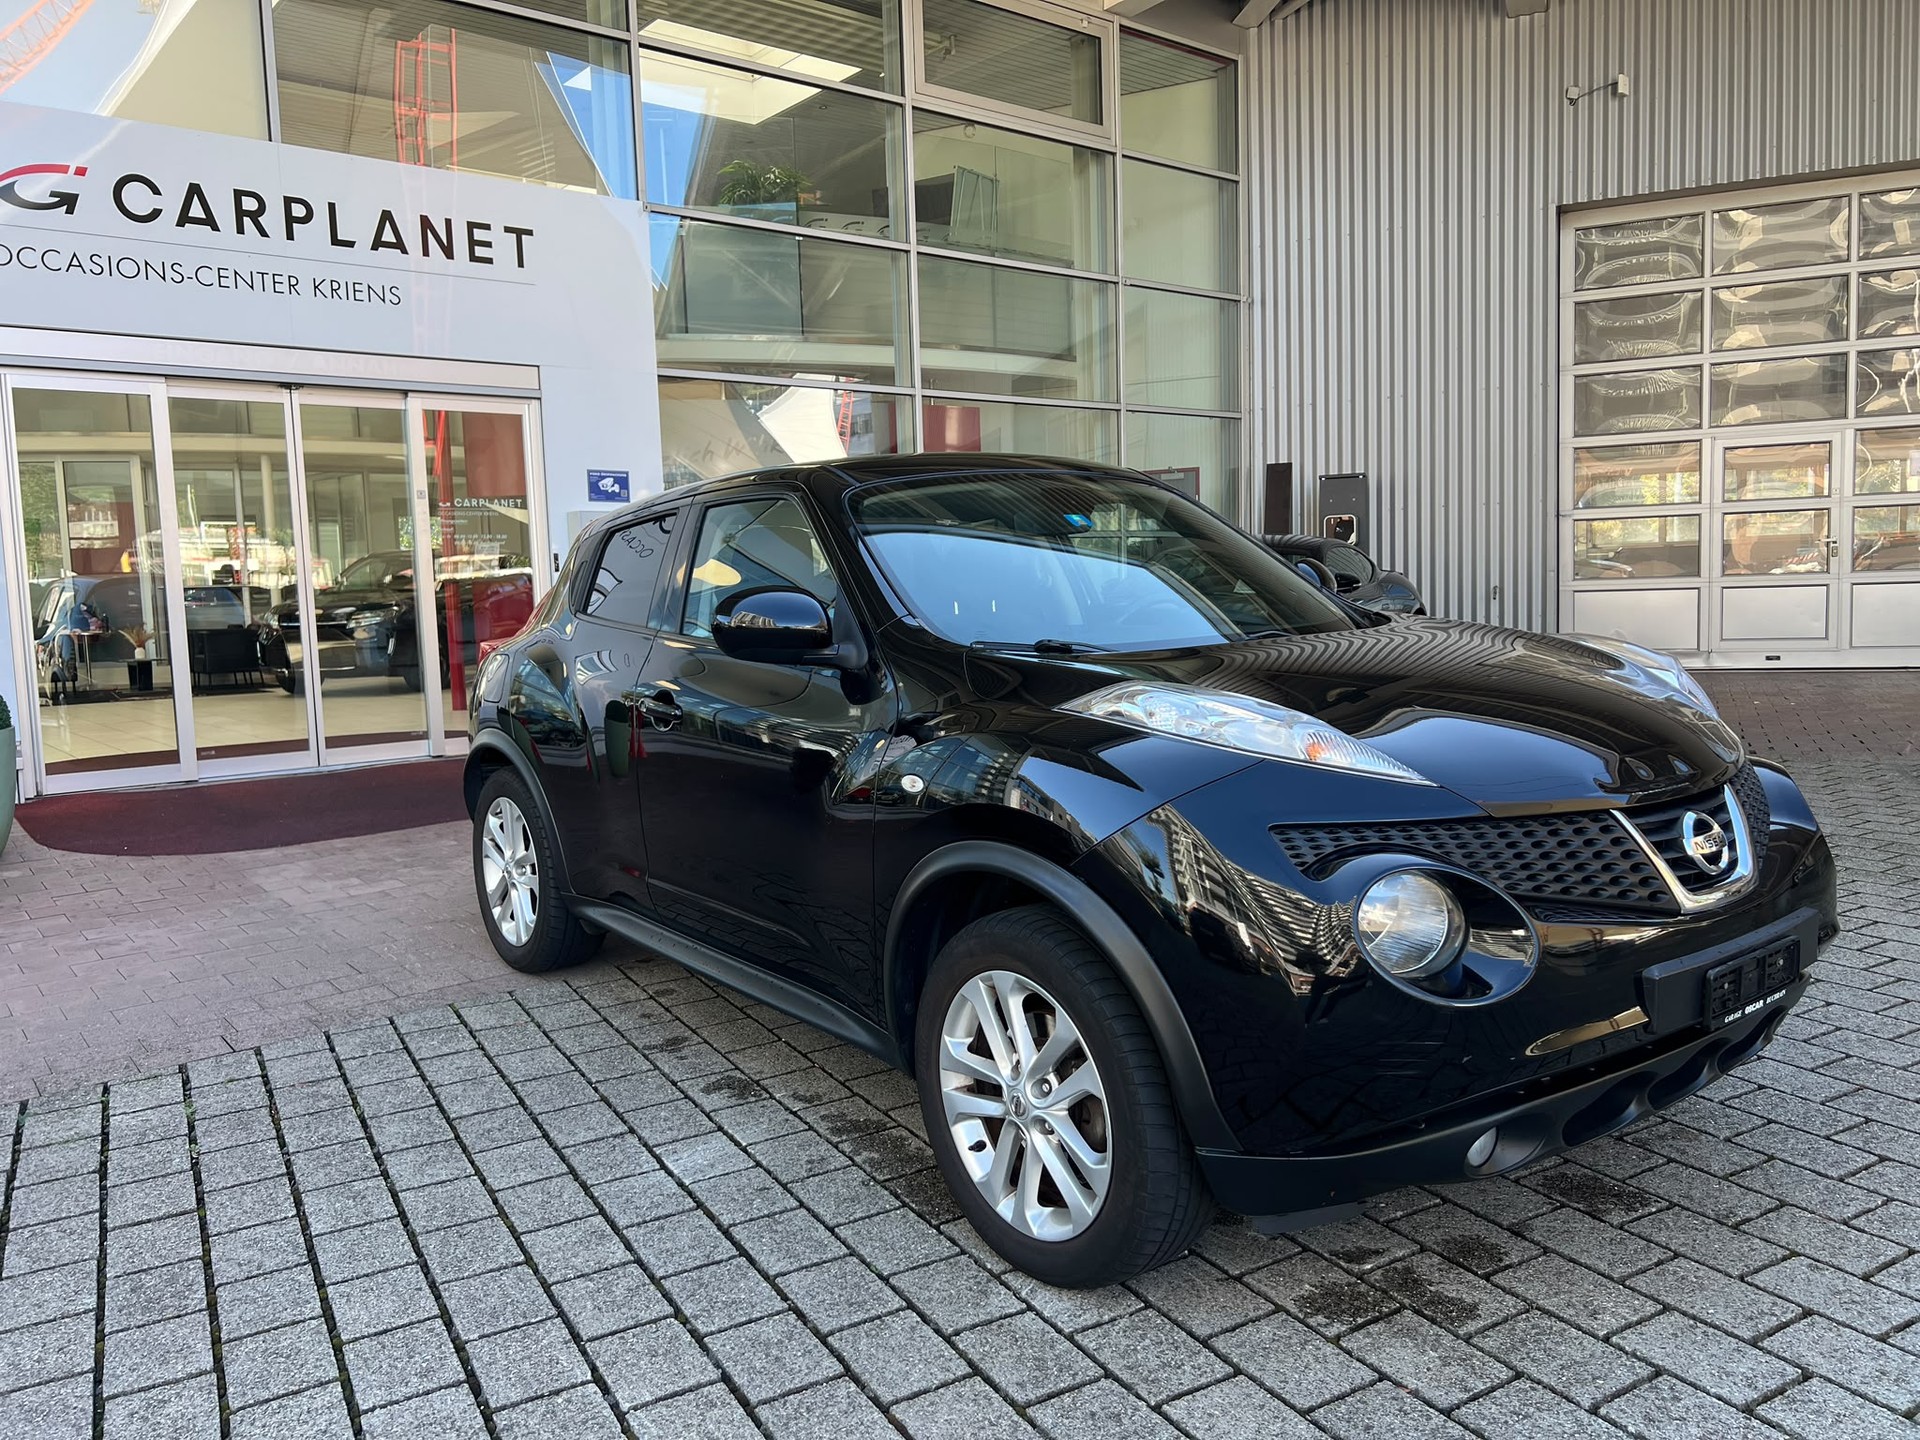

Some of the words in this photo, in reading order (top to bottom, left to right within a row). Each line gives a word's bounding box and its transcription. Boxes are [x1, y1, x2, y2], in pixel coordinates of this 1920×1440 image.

[112, 173, 534, 269] CARPLANET
[312, 277, 402, 306] KRIENS
[454, 498, 523, 508] CARPLANET
[1744, 999, 1764, 1015] OSCAR
